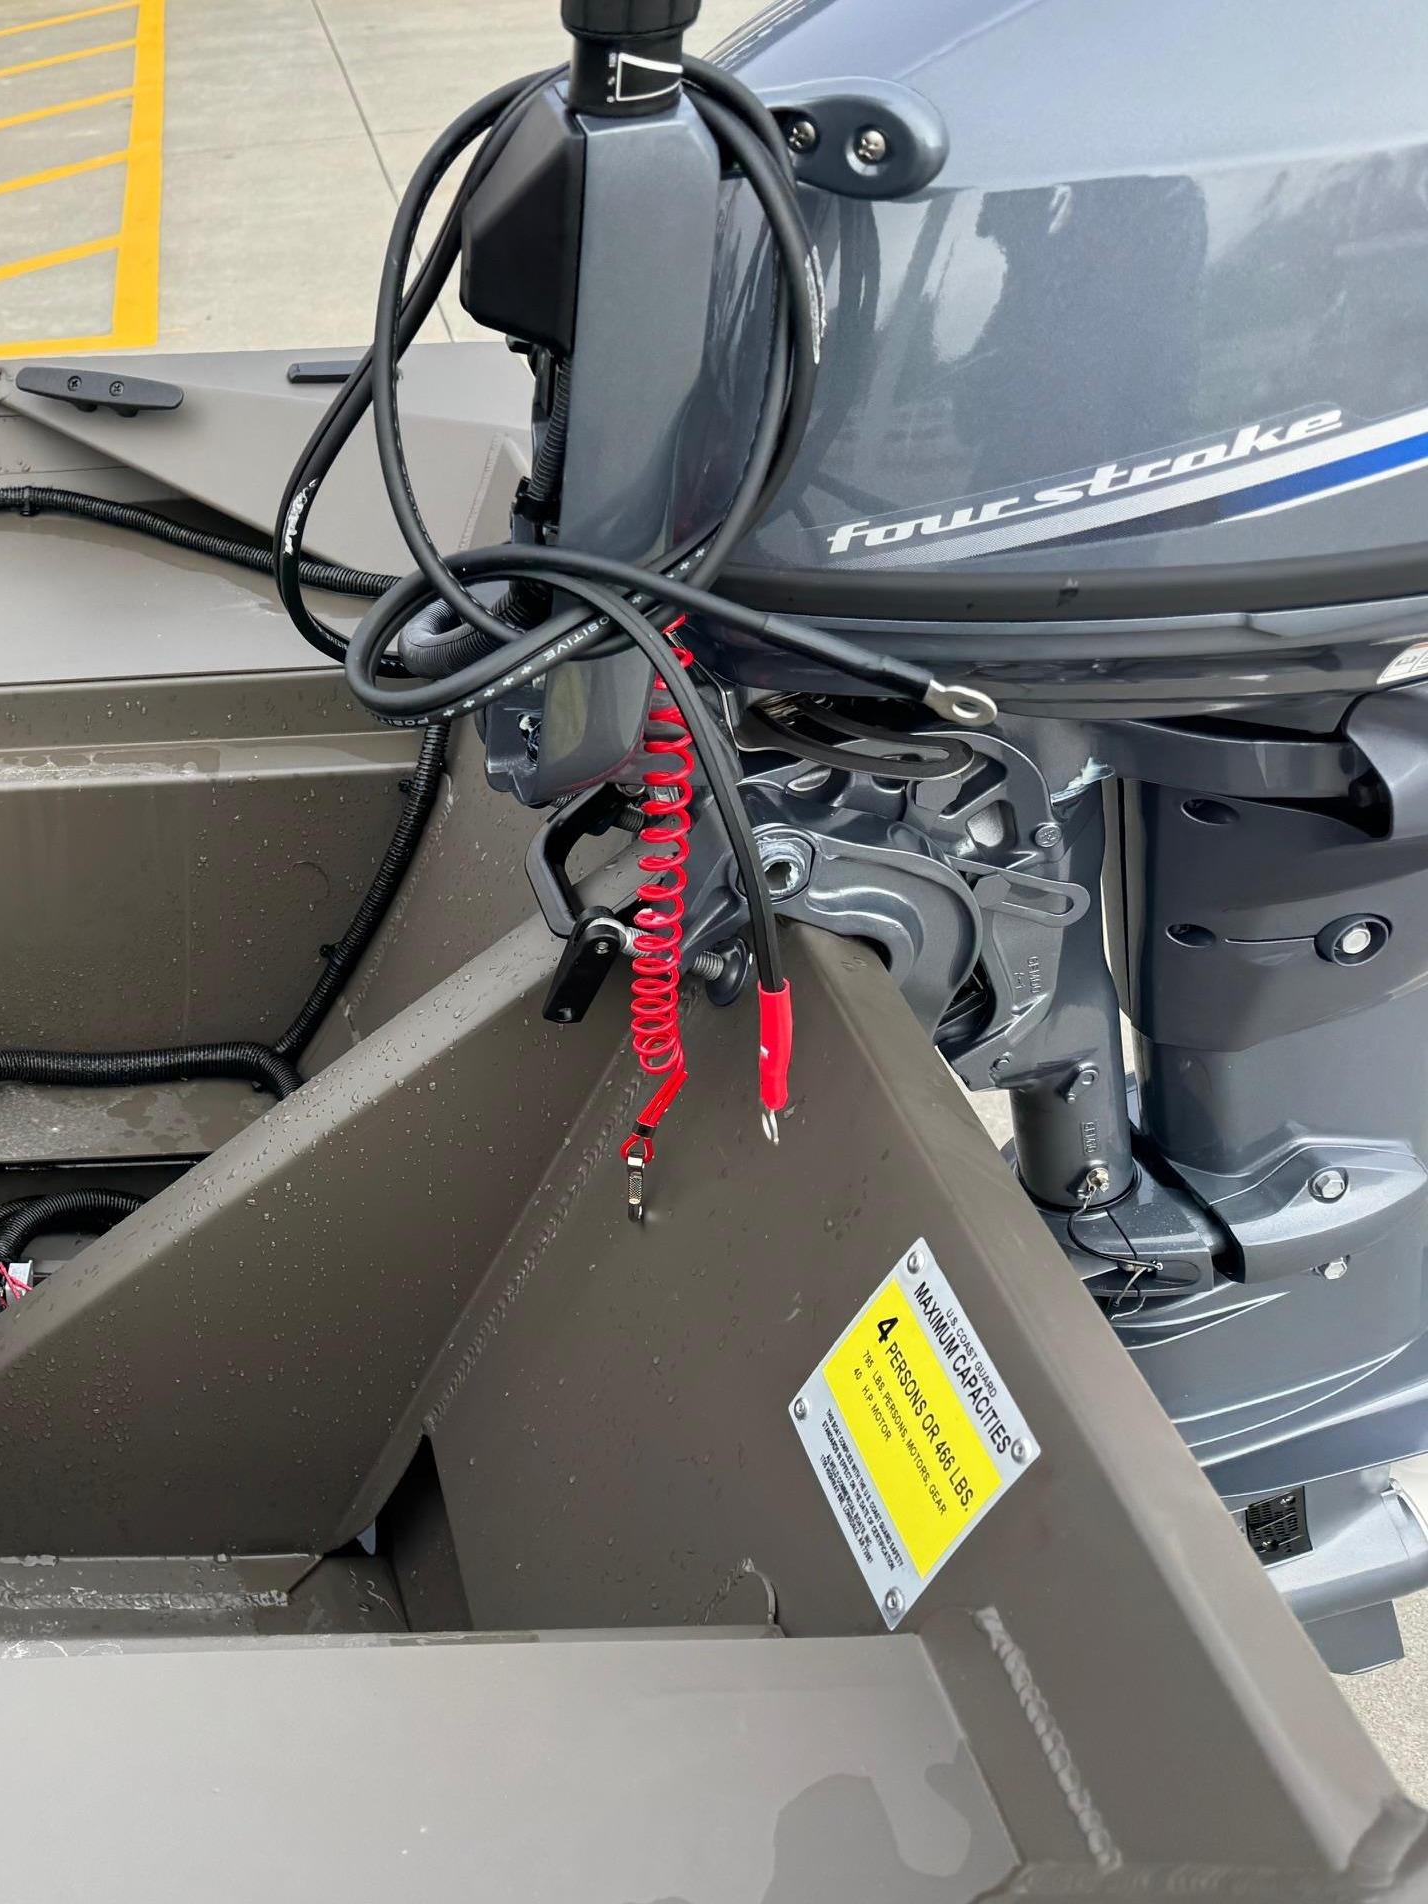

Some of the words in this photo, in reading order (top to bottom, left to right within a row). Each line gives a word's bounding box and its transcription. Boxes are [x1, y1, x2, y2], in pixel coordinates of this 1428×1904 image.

[828, 497, 1019, 554] four
[1019, 409, 1343, 506] stroke
[543, 616, 610, 661] OSITIVE
[876, 1316, 899, 1345] 4
[914, 1281, 960, 1360] MAXIMUM
[952, 1354, 1011, 1454] CAPACITIES
[945, 1307, 959, 1330] U.S.
[956, 1327, 978, 1361] COAST
[974, 1361, 997, 1398] GUARD
[853, 1366, 863, 1381] 40
[860, 1383, 875, 1407] H.P.
[871, 1403, 892, 1442] MOTOR
[885, 1341, 927, 1417] PERSONS
[871, 1369, 886, 1396] LBS.
[882, 1391, 908, 1442] PERSONS,
[905, 1438, 930, 1487] MOTORS,
[929, 1484, 947, 1516] GEAR
[920, 1411, 941, 1444] OR
[933, 1438, 956, 1473] 466
[858, 1477, 866, 1491] THE
[869, 1501, 882, 1523] COAST
[878, 1520, 892, 1545] GUARD
[889, 1542, 904, 1567] SAFETY
[949, 1466, 974, 1512] LBS.
